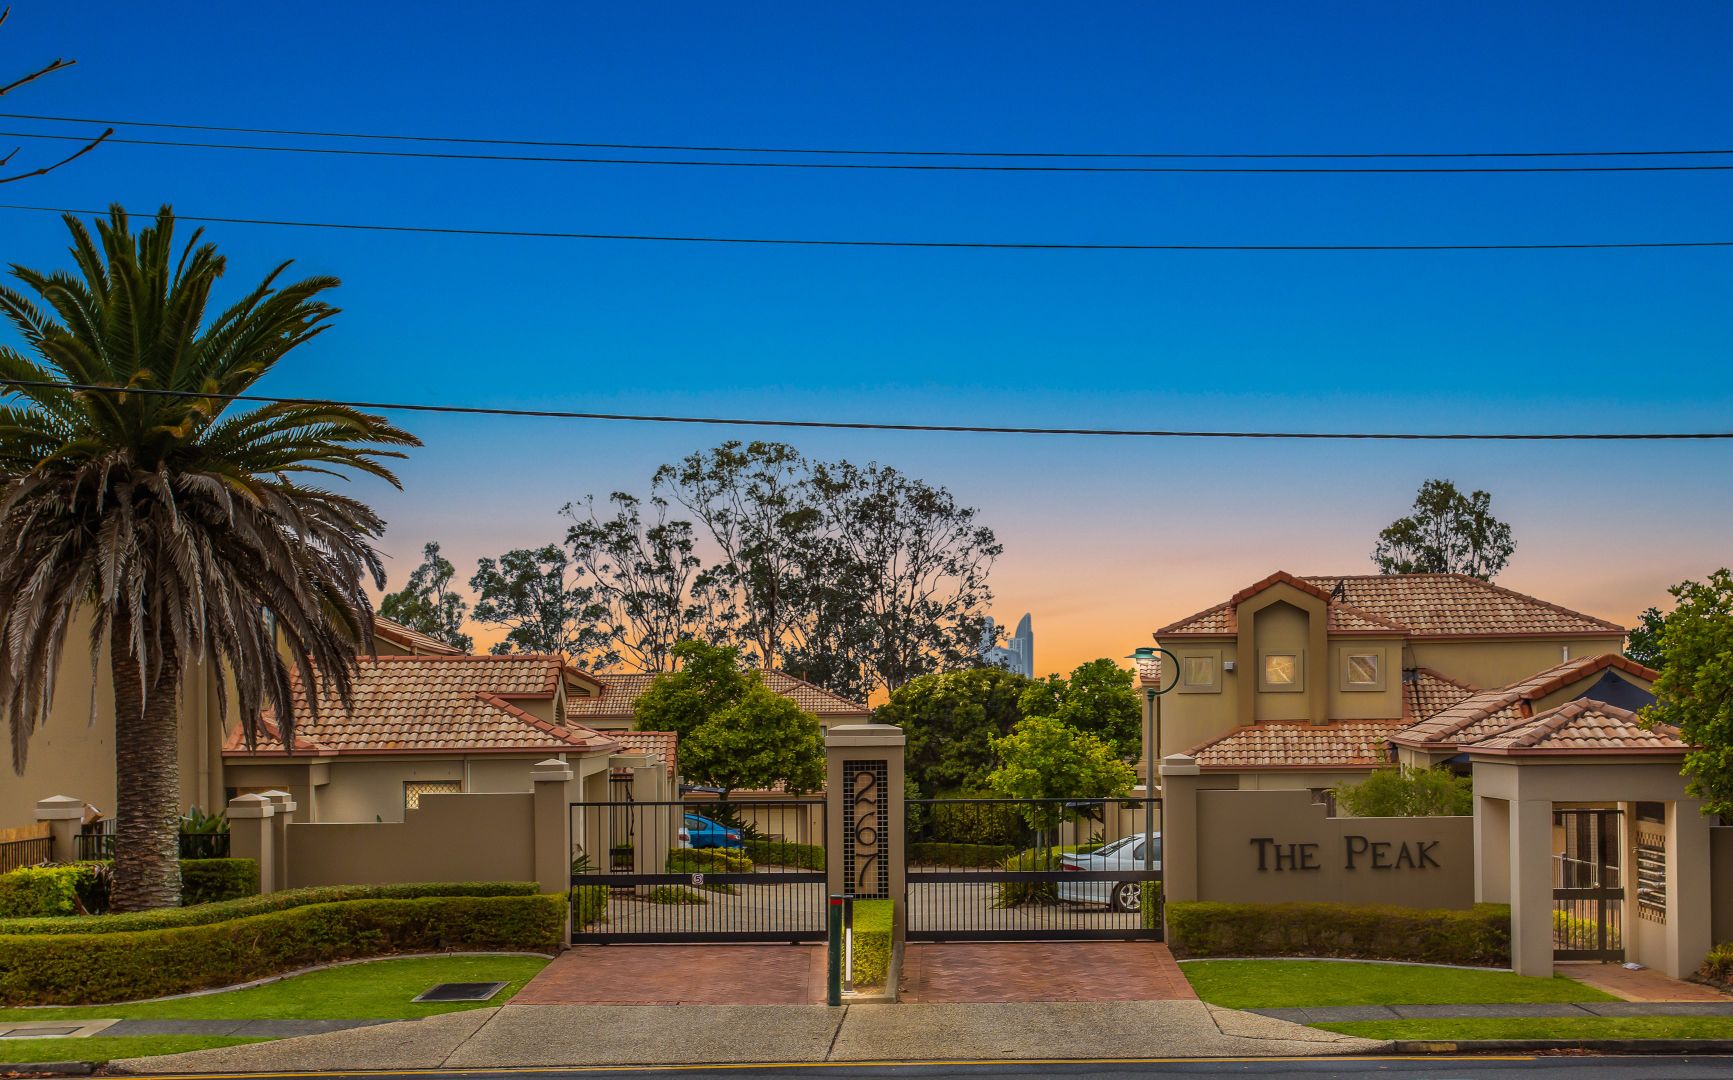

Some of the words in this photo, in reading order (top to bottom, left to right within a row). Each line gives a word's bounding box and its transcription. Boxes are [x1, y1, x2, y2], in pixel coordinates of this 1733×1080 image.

[854, 771, 879, 887] 267
[1250, 837, 1321, 872] THE
[1344, 835, 1441, 870] PEAK
